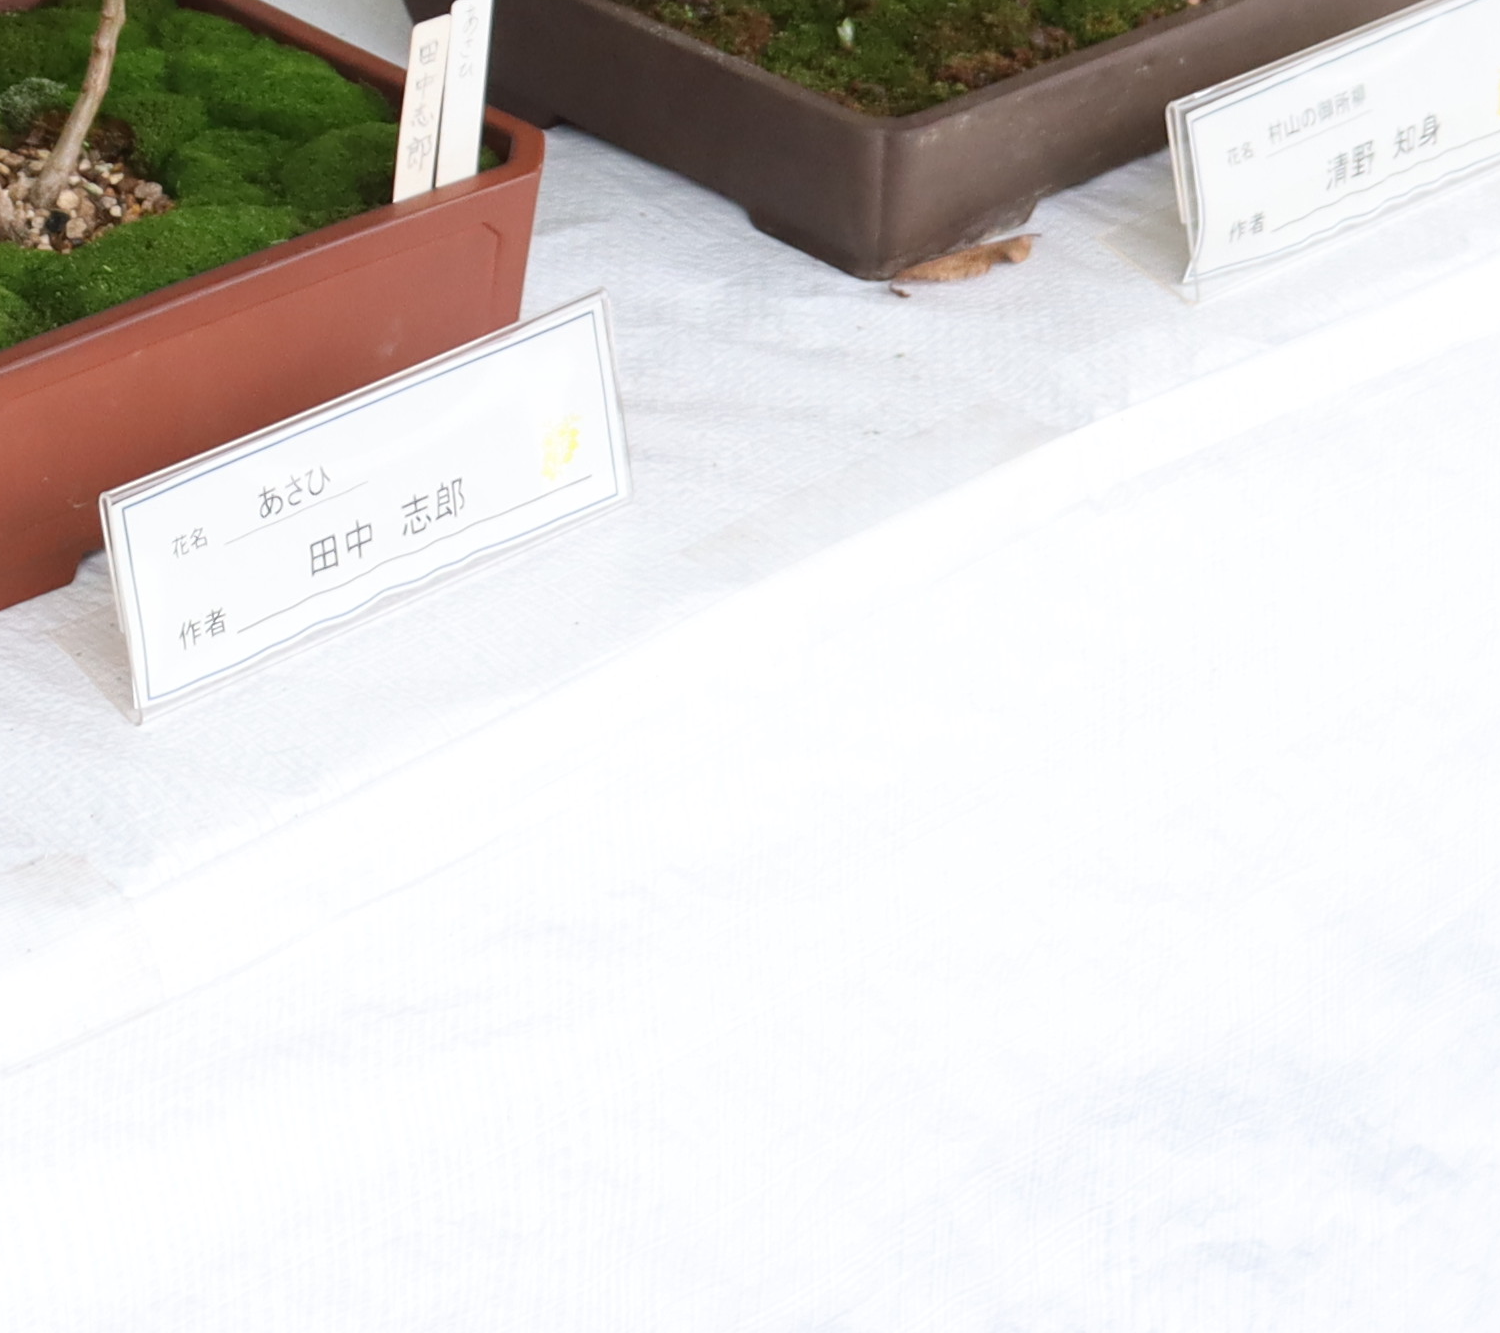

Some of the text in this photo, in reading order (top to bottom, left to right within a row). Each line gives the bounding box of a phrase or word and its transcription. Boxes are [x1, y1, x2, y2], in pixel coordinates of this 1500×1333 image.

[1324, 138, 1377, 192] 清野
[1228, 210, 1266, 246] 作者
[170, 465, 332, 559] 花名 あさひ
[309, 476, 466, 577] 田中 志郎
[178, 606, 227, 651] 作者
